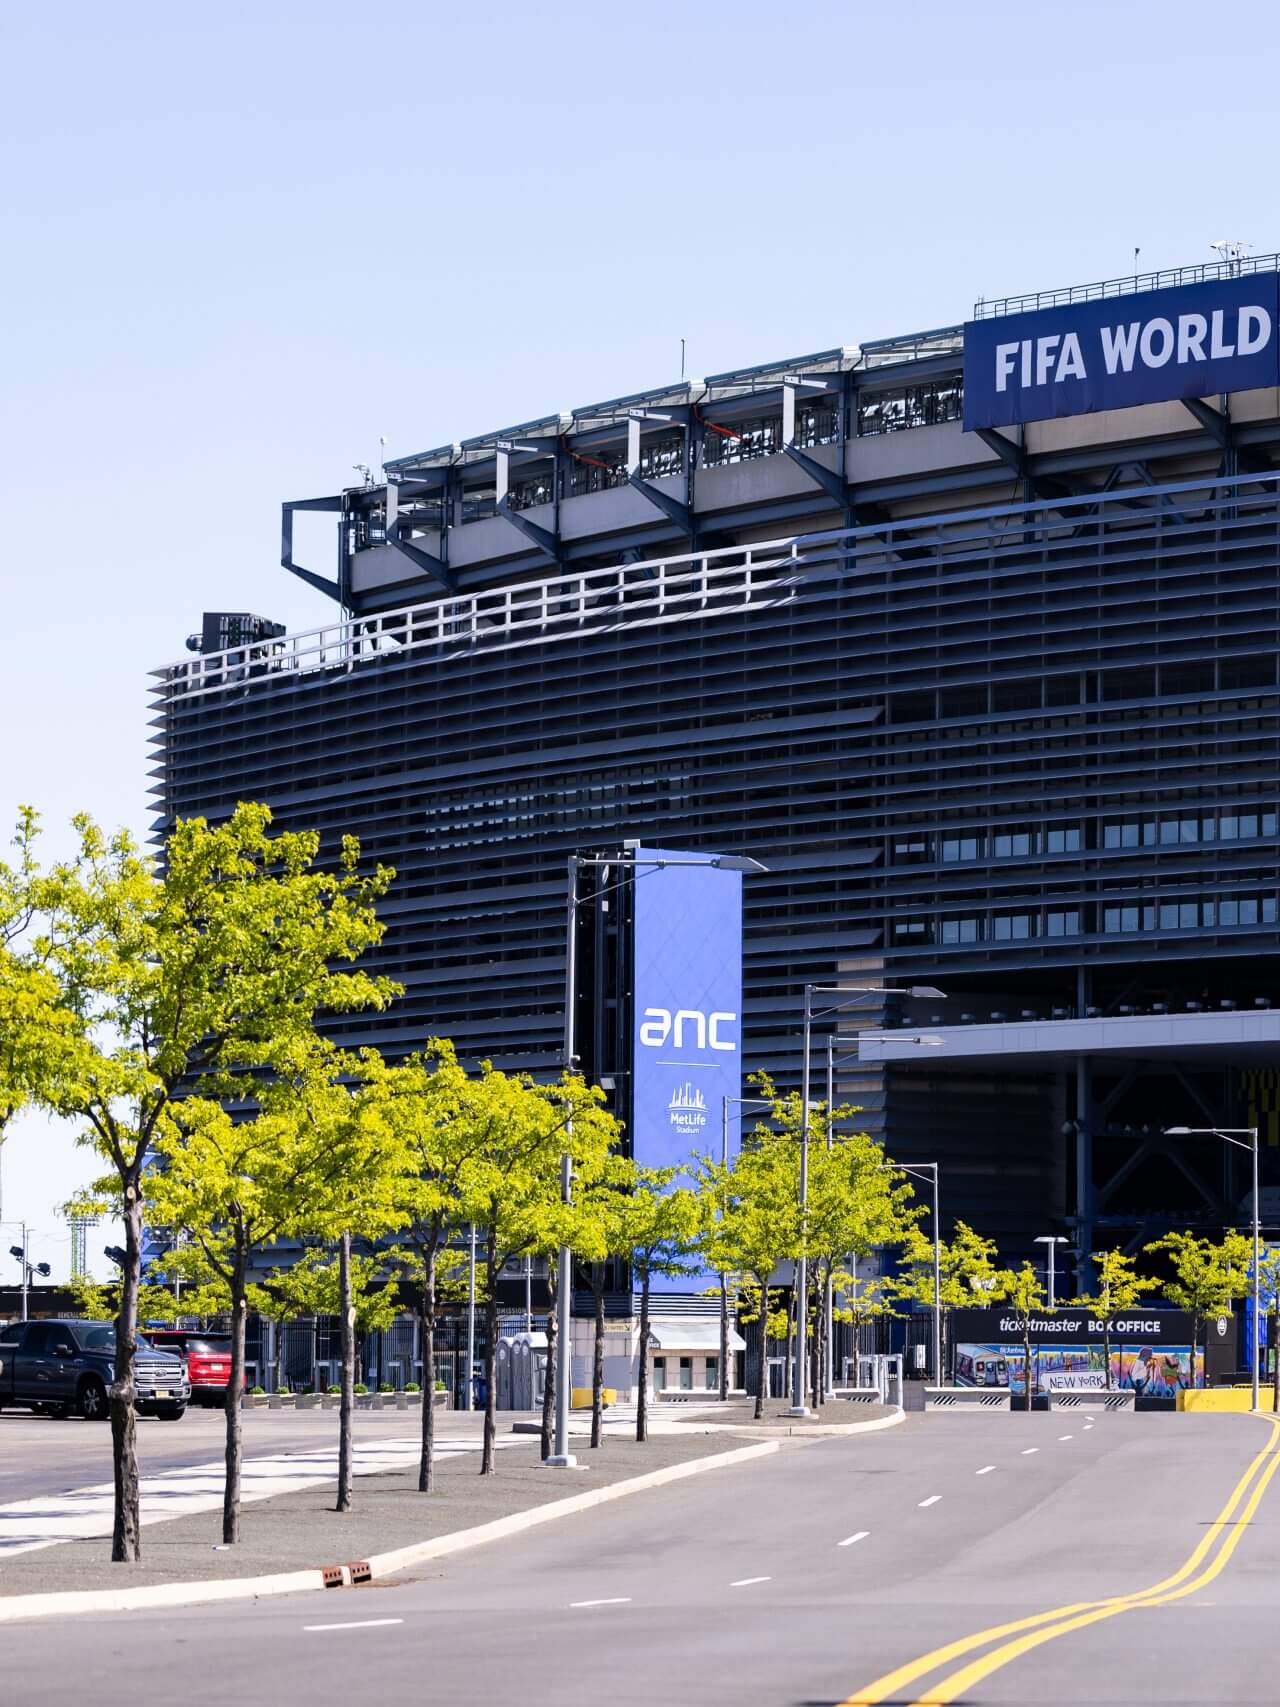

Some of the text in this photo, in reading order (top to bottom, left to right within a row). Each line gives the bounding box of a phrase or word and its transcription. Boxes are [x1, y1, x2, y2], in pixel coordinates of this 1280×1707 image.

[994, 333, 1087, 392] FIFA
[1100, 305, 1272, 375] WORLD
[639, 1007, 737, 1051] anc
[670, 1112, 707, 1126] MetLife
[675, 1126, 700, 1135] Stadium
[999, 1317, 1161, 1333] ticketmaster BOX OFFICE
[1049, 1376, 1076, 1389] NEW
